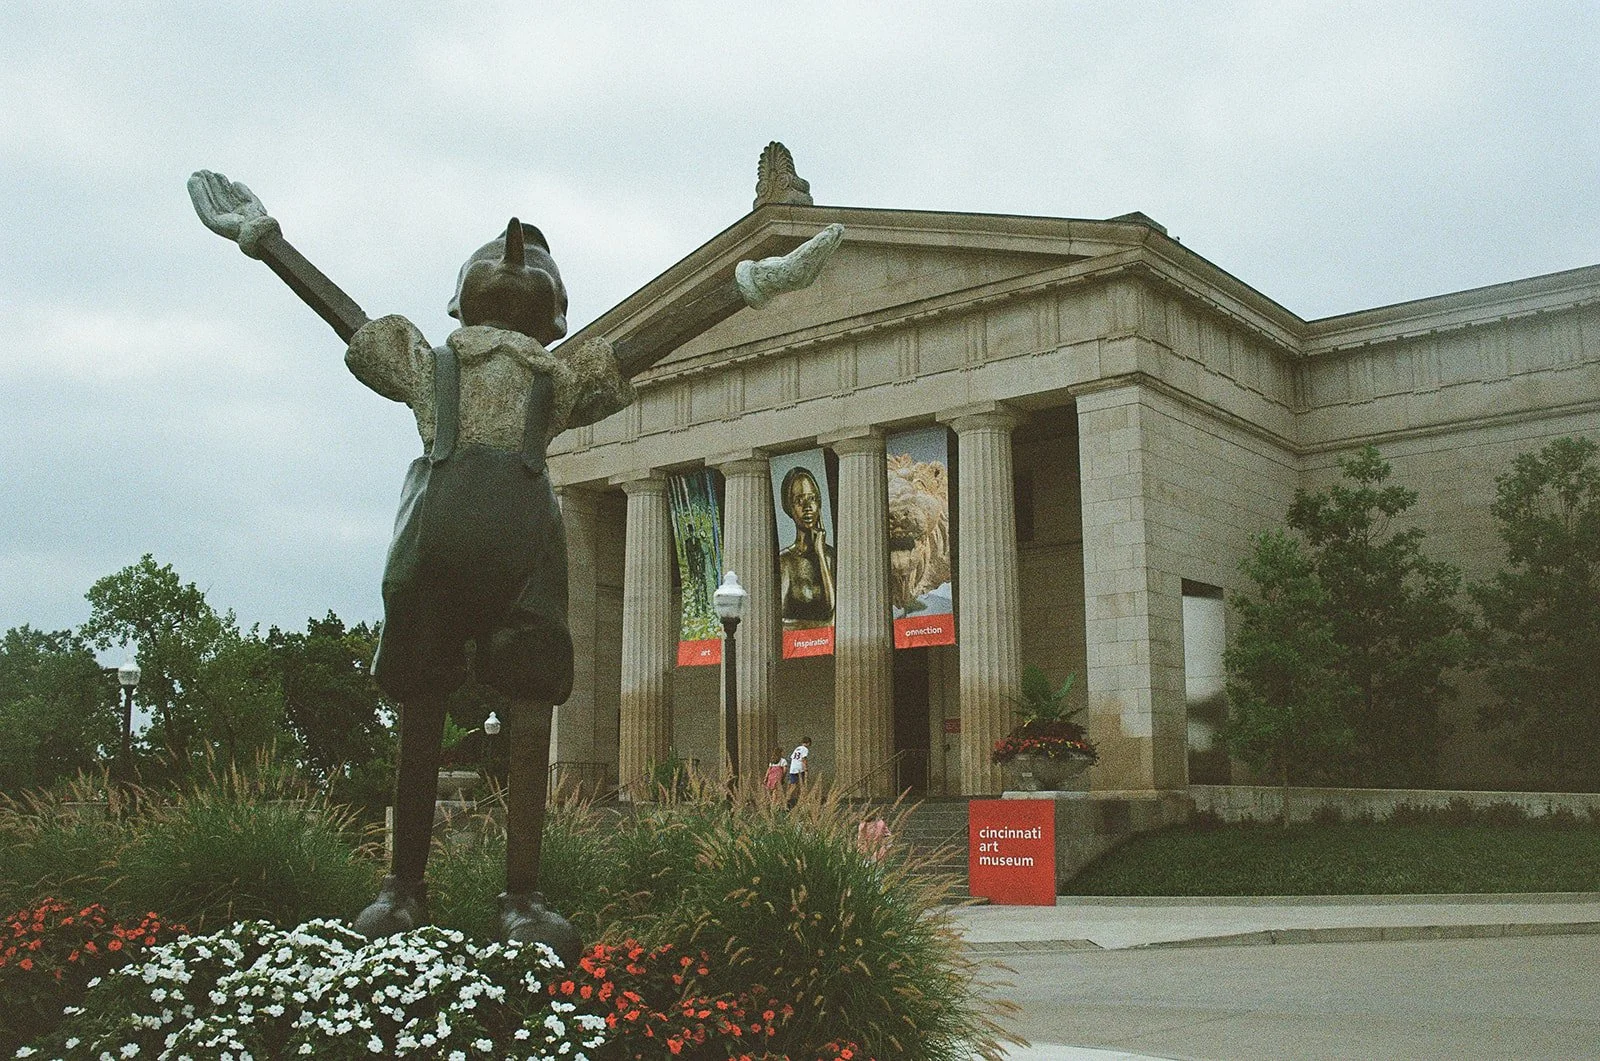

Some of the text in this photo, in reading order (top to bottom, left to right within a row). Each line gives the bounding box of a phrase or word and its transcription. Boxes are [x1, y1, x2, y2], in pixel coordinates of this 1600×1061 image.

[794, 637, 829, 648] inspiration
[700, 648, 711, 656] art
[979, 826, 1041, 839] cincinnati
[979, 841, 999, 852] art
[979, 855, 1034, 866] museum
